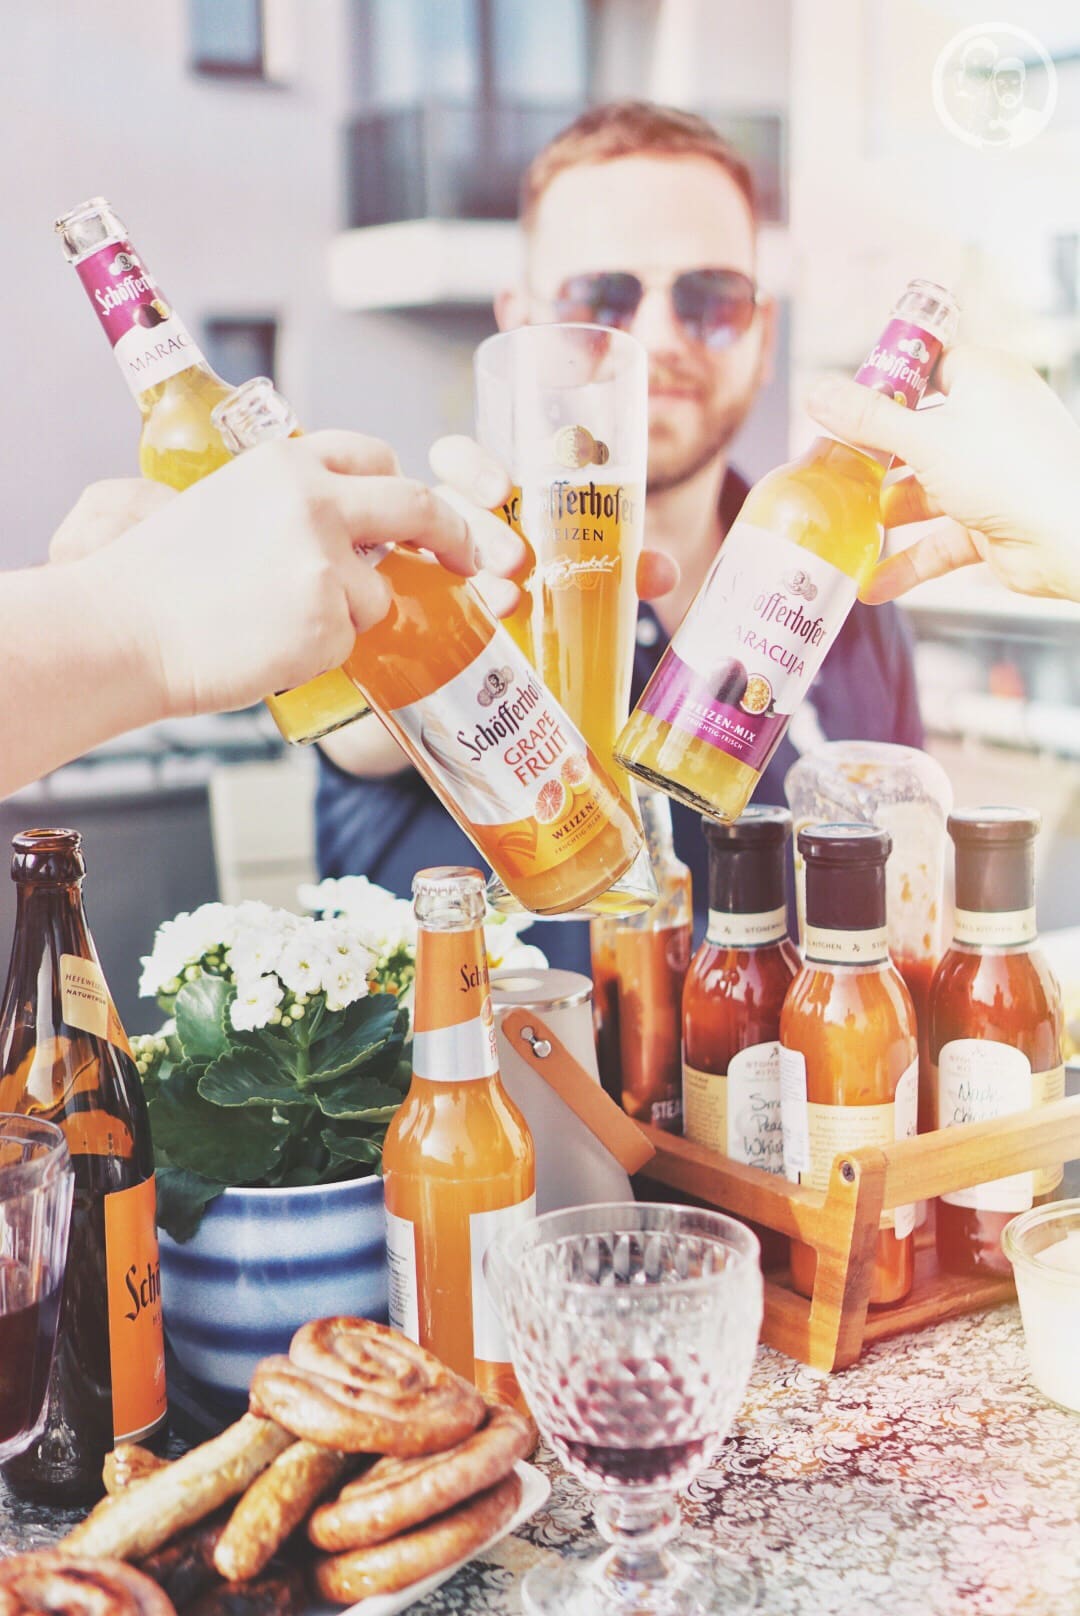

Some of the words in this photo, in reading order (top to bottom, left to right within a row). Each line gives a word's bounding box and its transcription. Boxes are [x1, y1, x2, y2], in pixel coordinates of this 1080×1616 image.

[544, 528, 605, 544] EIZEN
[736, 624, 806, 678] ARACUJA
[503, 709, 555, 766] GRAPE
[513, 724, 568, 788] FRUIT
